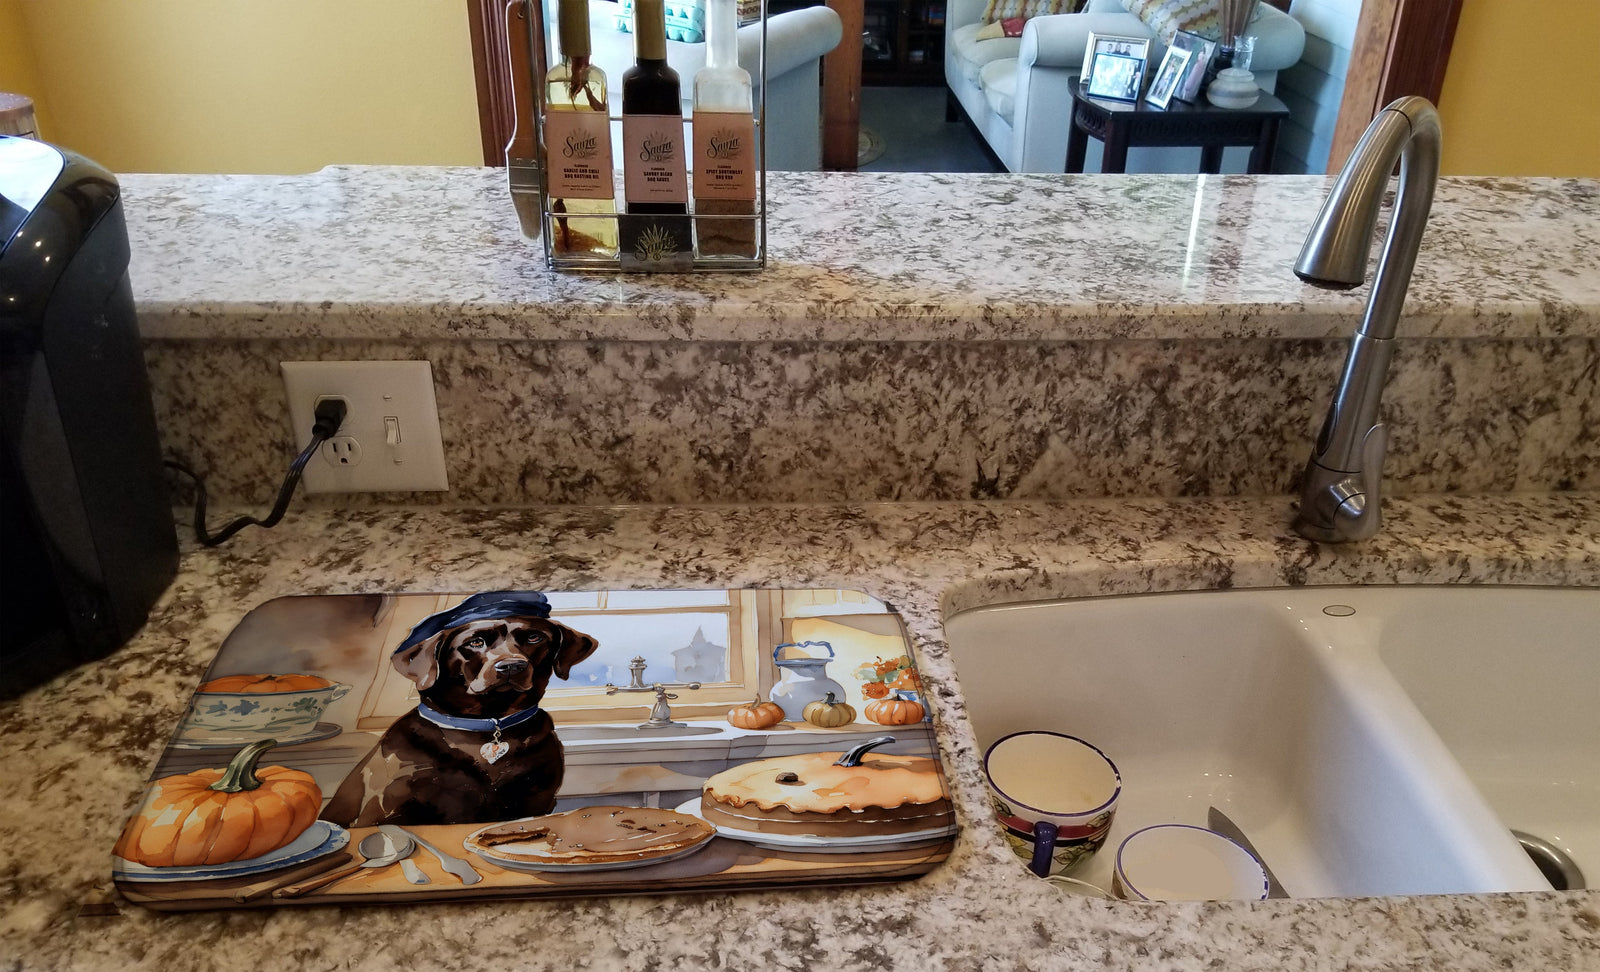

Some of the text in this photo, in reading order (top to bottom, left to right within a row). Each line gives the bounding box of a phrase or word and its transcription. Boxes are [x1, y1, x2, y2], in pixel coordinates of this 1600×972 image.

[563, 136, 598, 158] Sauza
[640, 140, 673, 161] Sauza
[707, 136, 740, 158] Sauza
